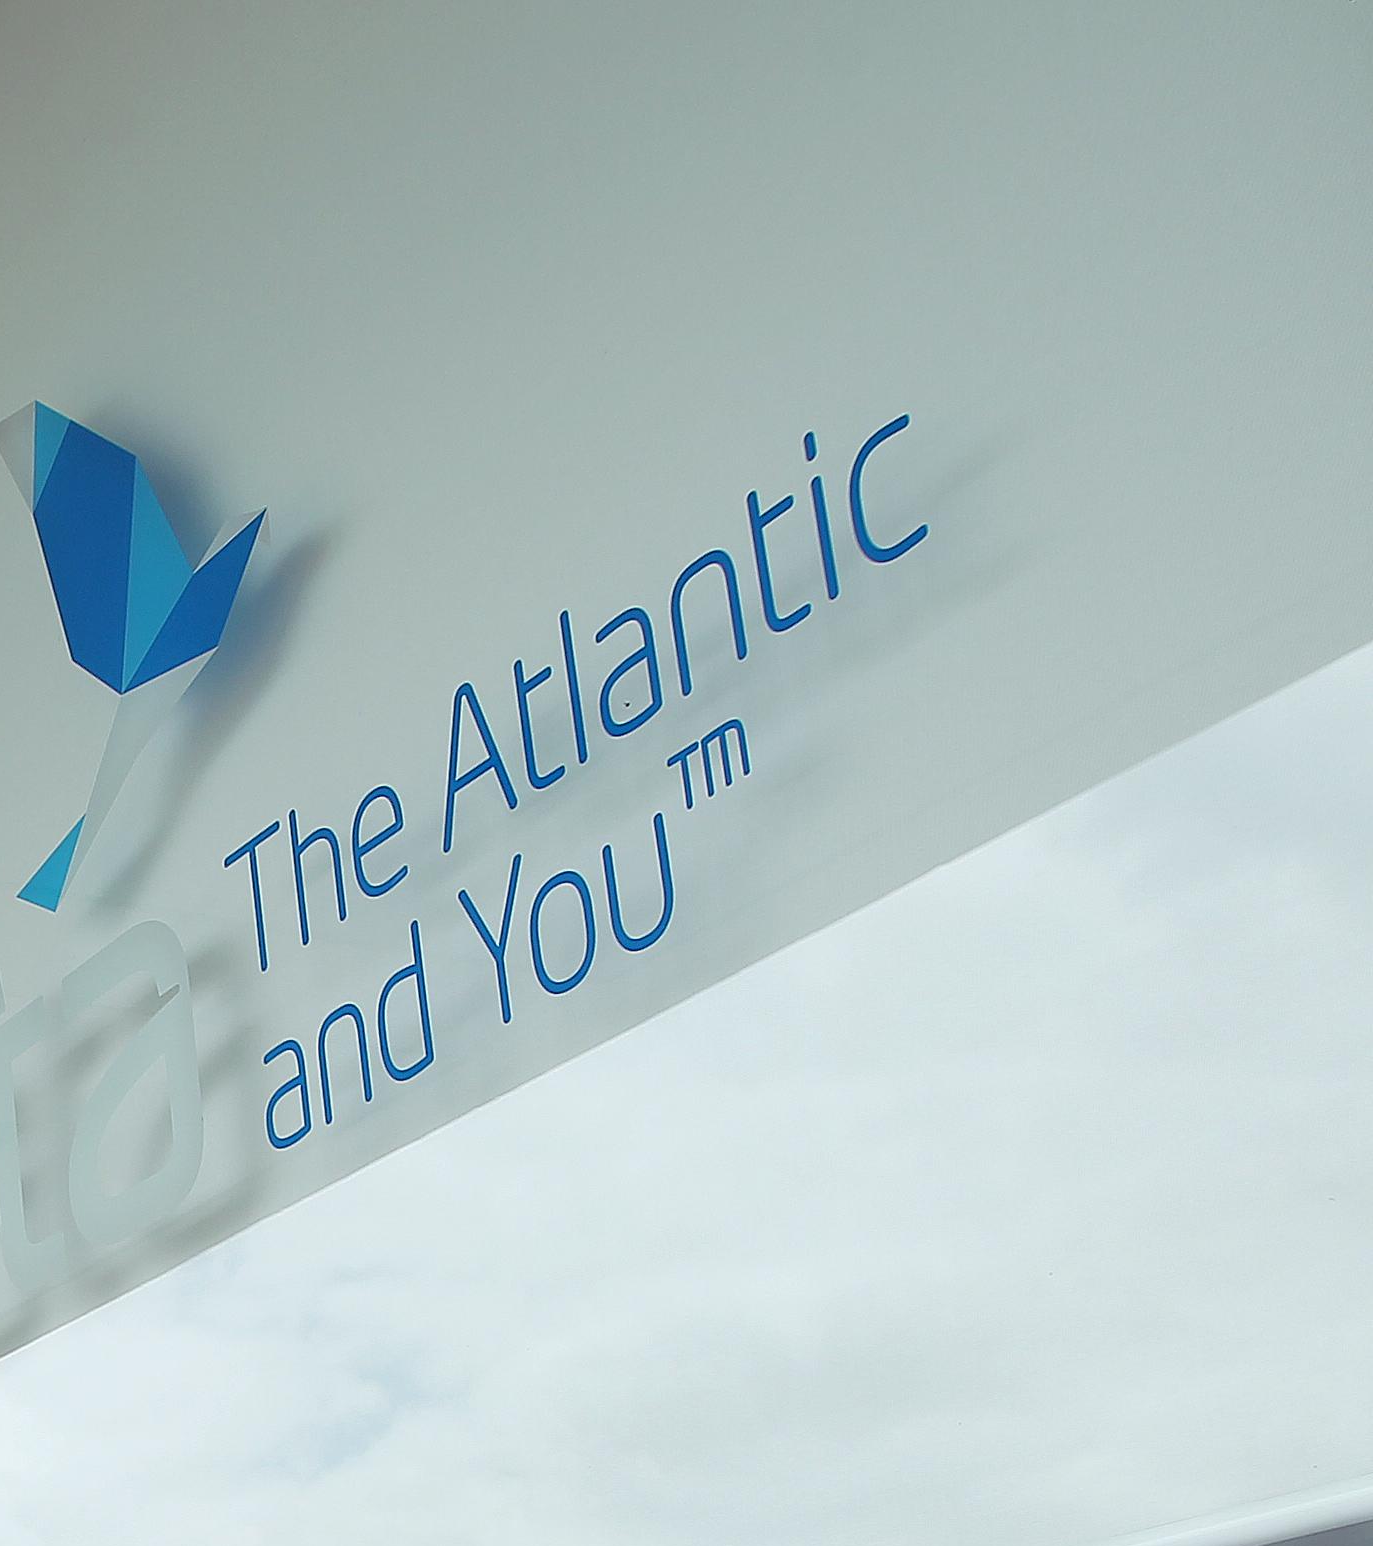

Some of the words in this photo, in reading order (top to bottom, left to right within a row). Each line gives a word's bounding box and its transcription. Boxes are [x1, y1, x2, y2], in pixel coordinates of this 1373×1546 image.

[224, 784, 410, 971] The
[442, 413, 931, 853] Atlantic
[263, 920, 436, 1150] and
